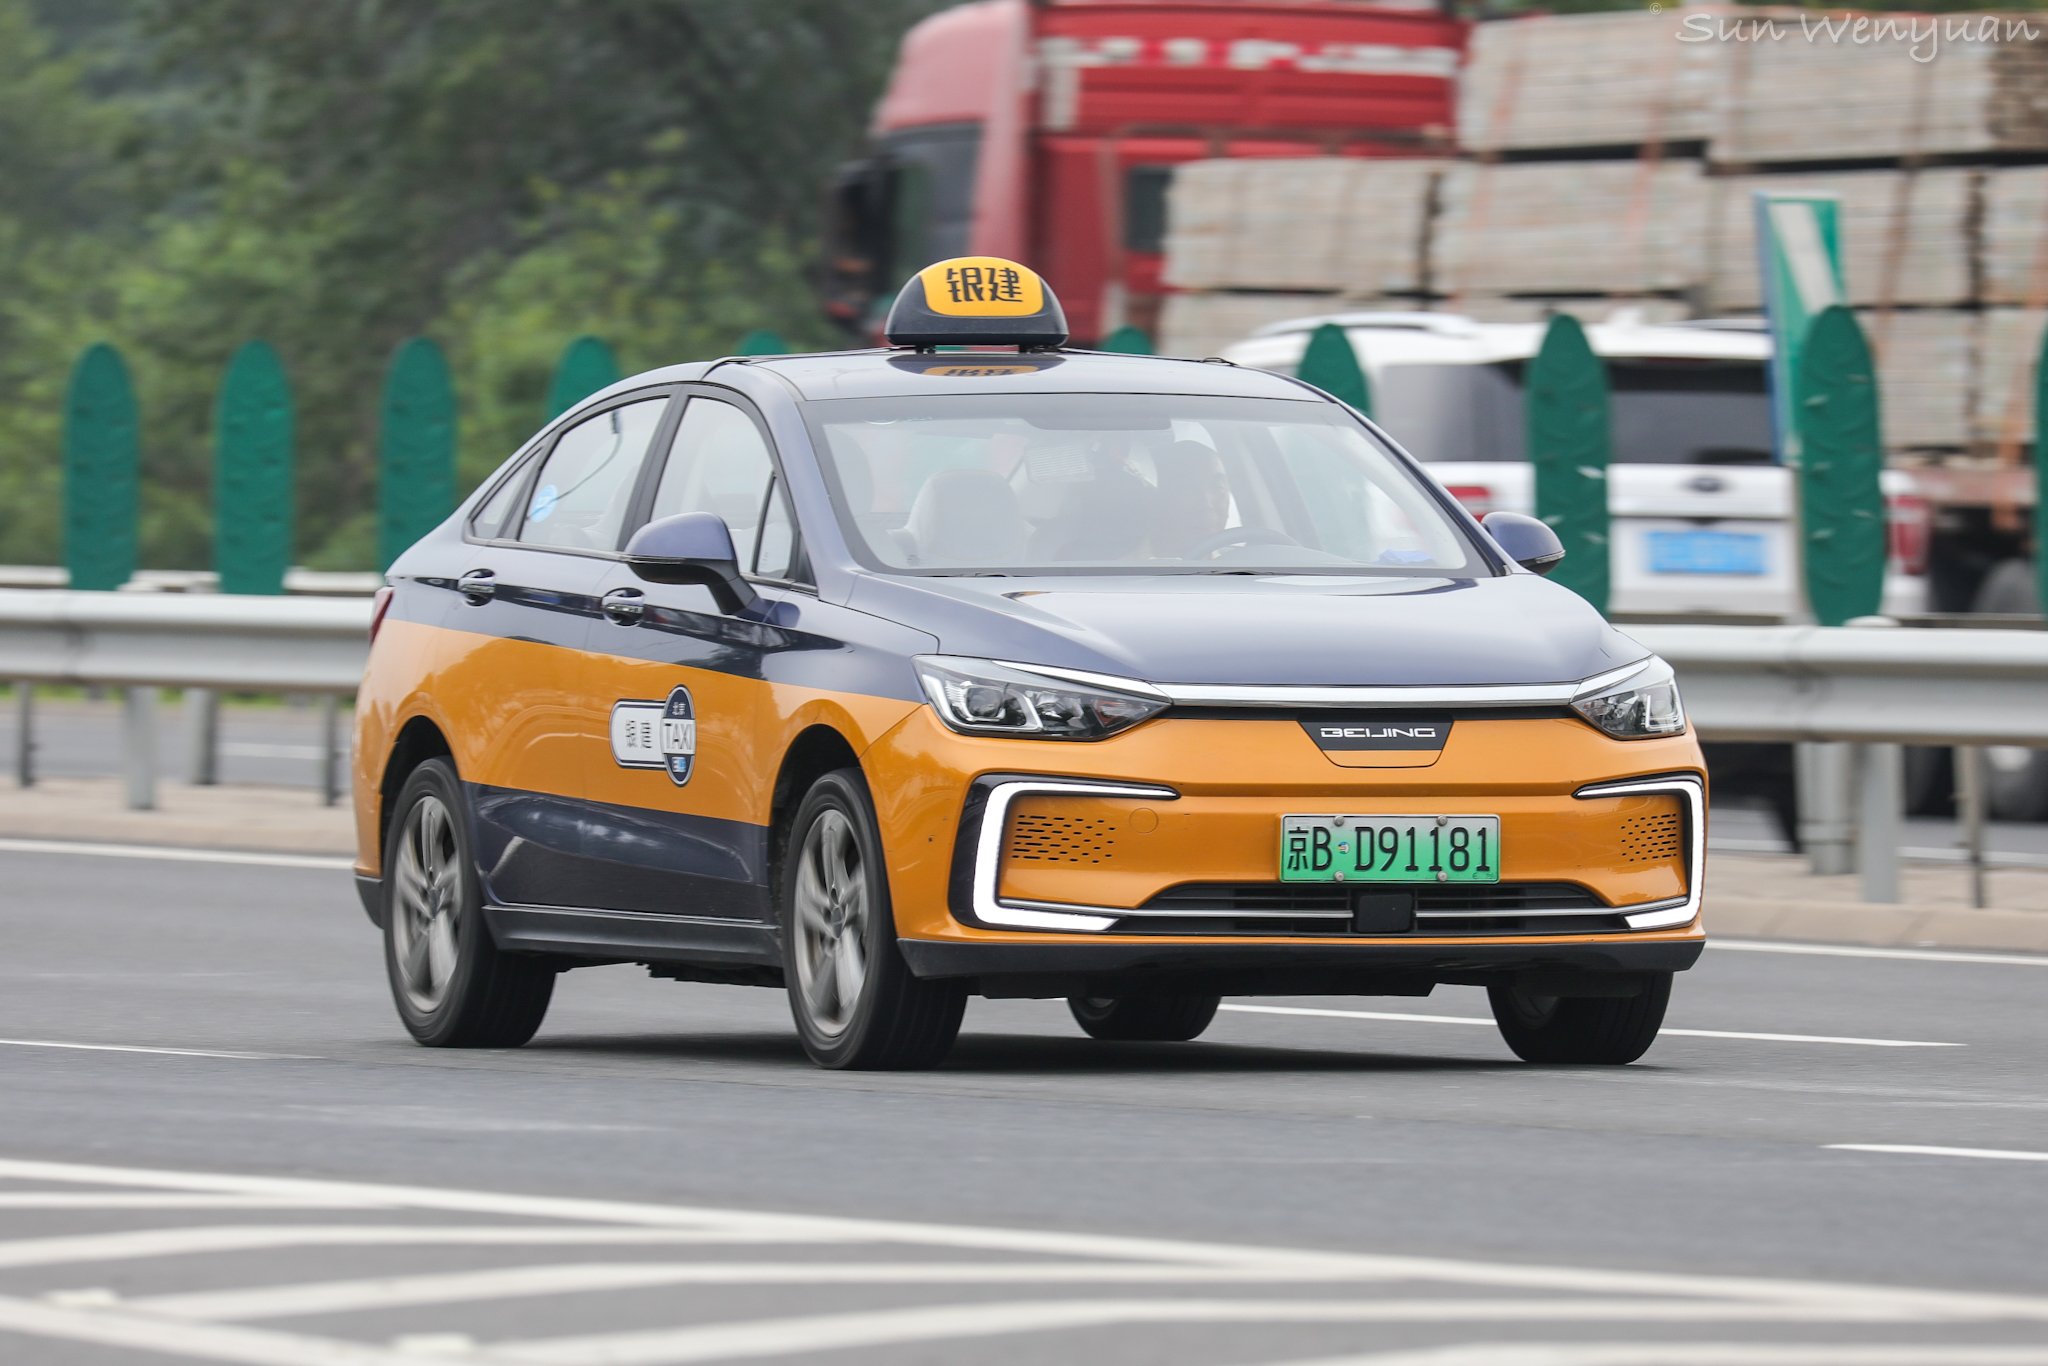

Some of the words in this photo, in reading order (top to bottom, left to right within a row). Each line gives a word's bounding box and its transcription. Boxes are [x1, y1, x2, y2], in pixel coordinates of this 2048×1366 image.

[946, 266, 1023, 303] 银建
[663, 722, 694, 751] TAXI
[1320, 727, 1436, 738] BEIJING
[1354, 826, 1490, 871] D91181
